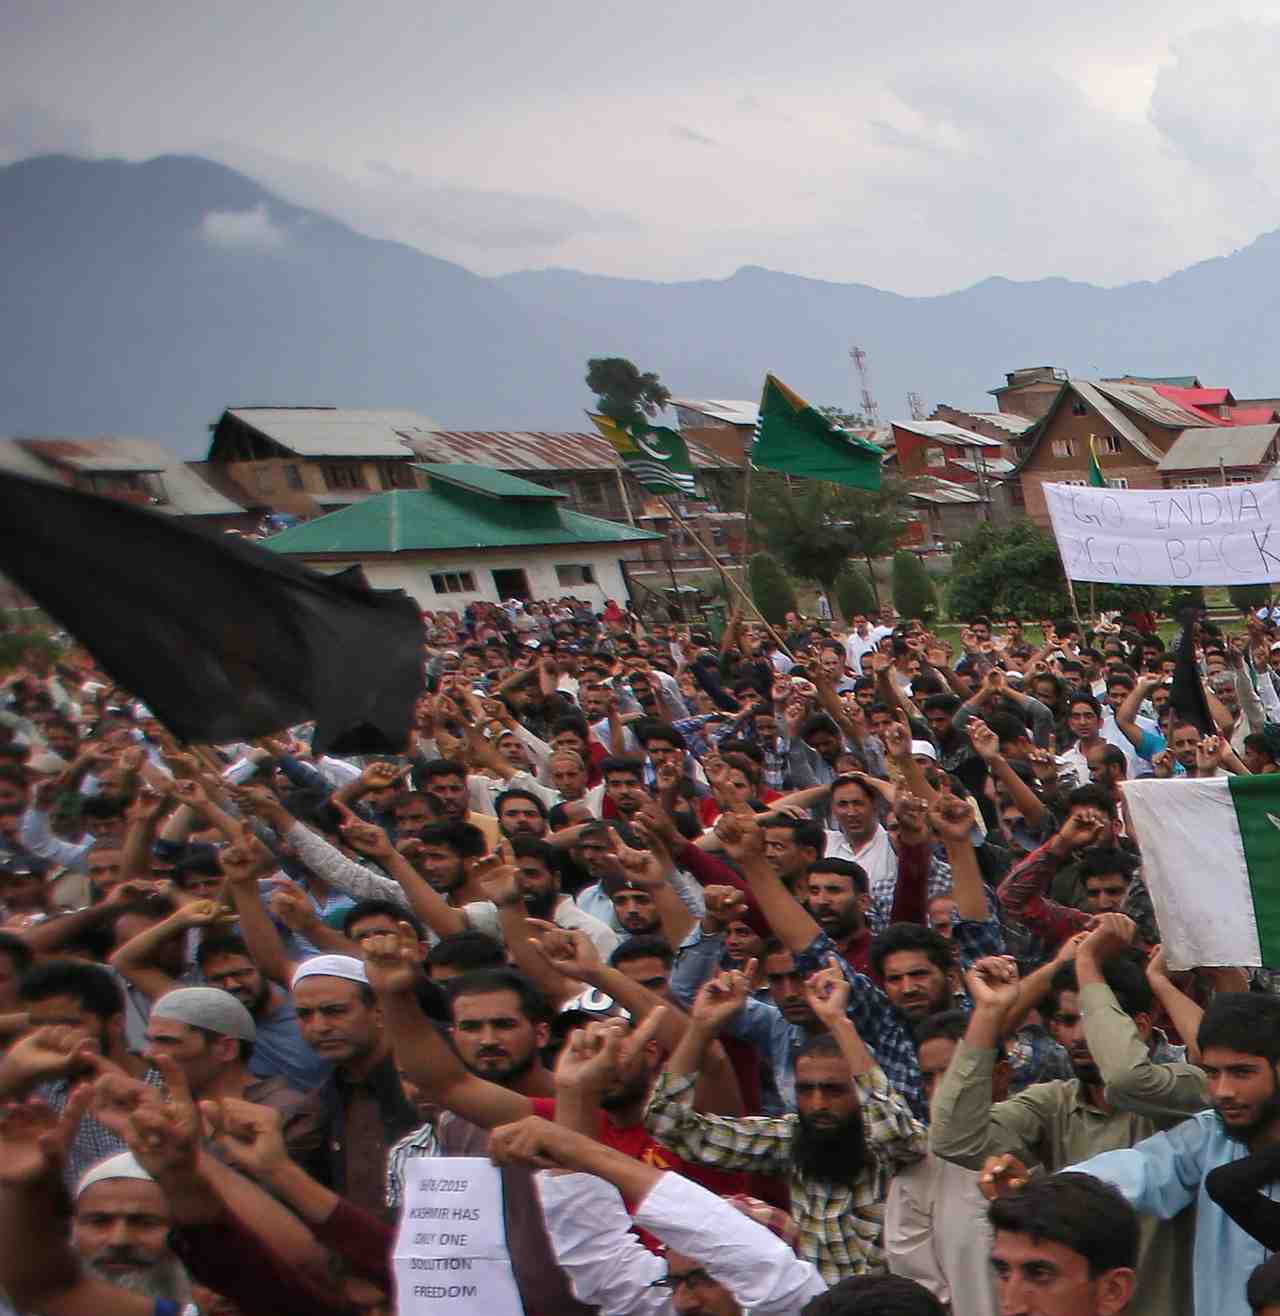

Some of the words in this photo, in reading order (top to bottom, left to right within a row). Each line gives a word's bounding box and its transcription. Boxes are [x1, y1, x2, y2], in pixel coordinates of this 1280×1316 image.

[1149, 488, 1263, 530] INDIA
[452, 1207, 481, 1221] HAS
[439, 1232, 469, 1247] ONE
[408, 1257, 473, 1271] SOLUTION
[413, 1284, 479, 1299] FREEDOM
